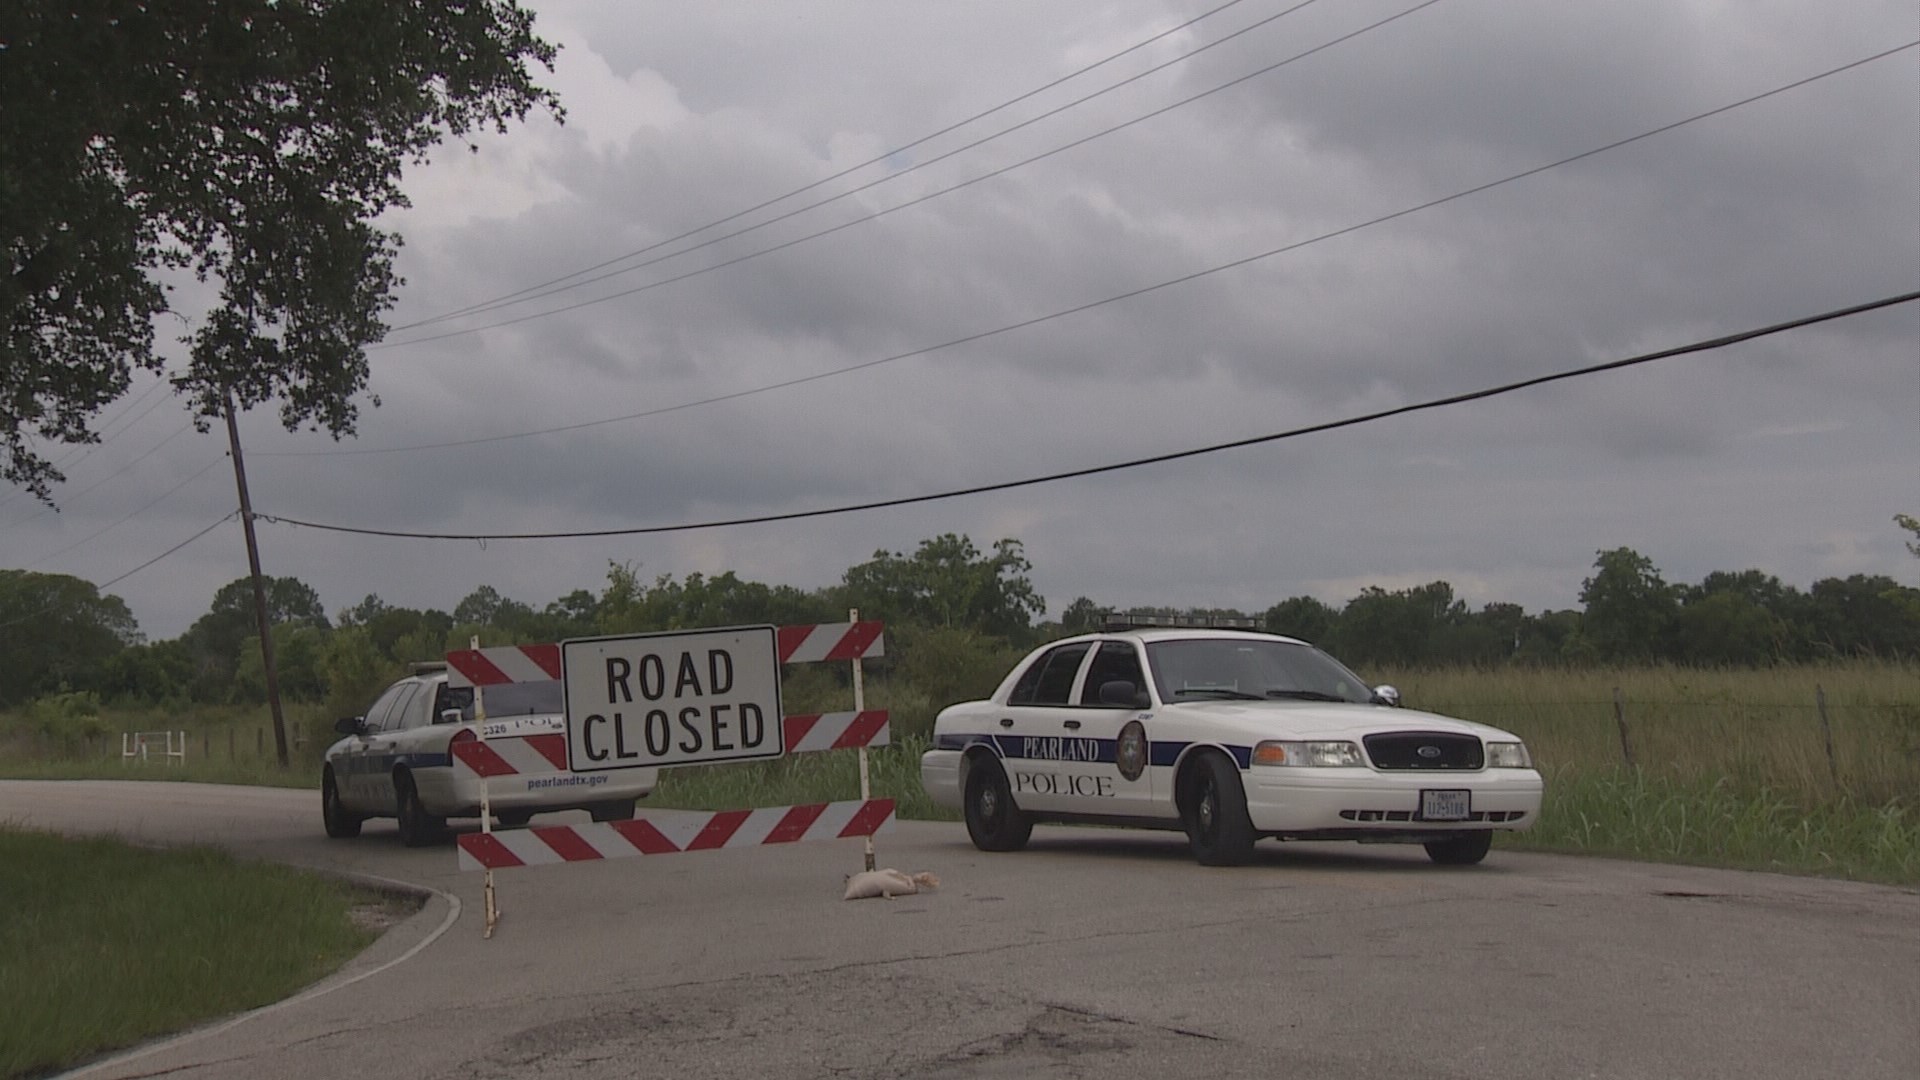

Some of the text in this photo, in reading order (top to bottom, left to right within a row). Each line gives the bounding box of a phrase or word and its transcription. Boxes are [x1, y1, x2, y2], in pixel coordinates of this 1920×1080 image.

[606, 649, 734, 704] ROAD
[583, 703, 764, 762] CLOSED
[1023, 737, 1099, 761] PEARLAND
[527, 775, 608, 791] pearlandtx.gov
[1015, 772, 1115, 797] POLICE
